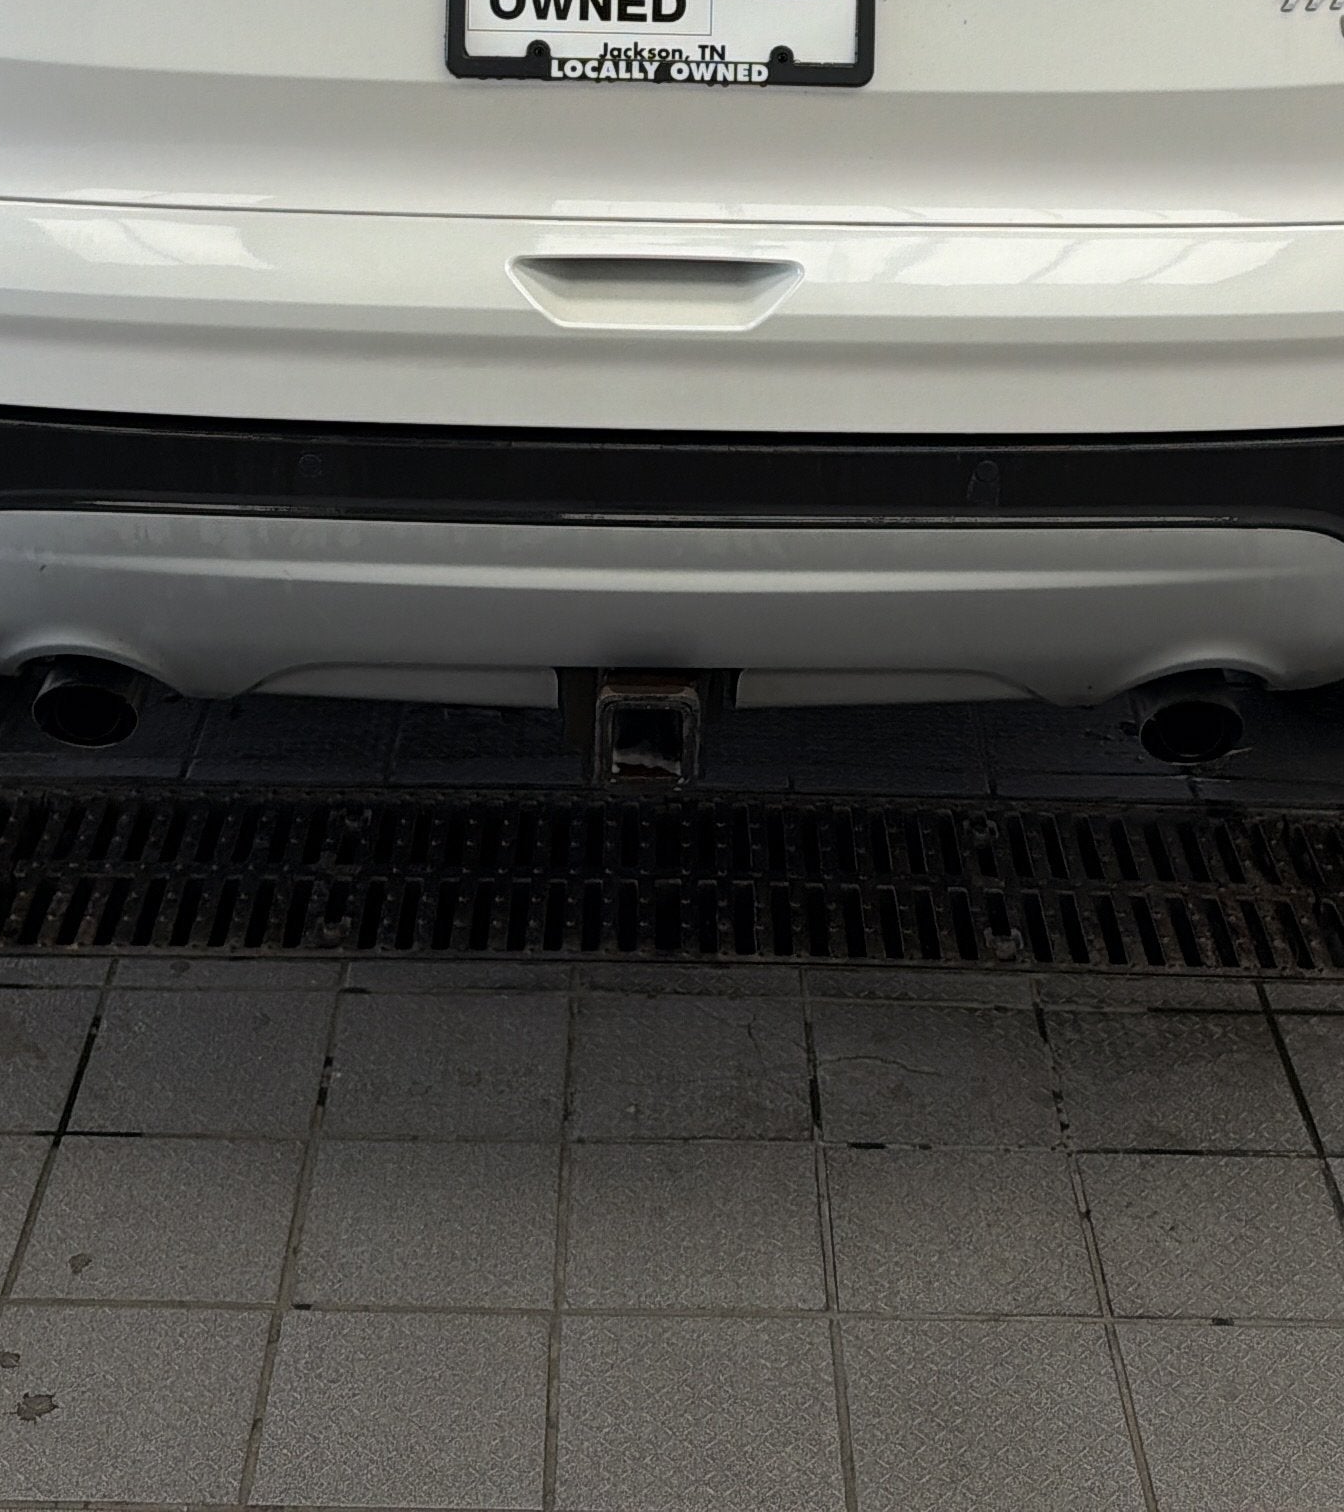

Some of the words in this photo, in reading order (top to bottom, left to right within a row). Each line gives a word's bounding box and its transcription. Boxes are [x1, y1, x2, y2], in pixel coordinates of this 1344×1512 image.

[599, 41, 690, 61] Jackson,
[698, 44, 727, 61] TN
[551, 59, 660, 80] LOCALLY
[670, 62, 769, 82] OWNED
